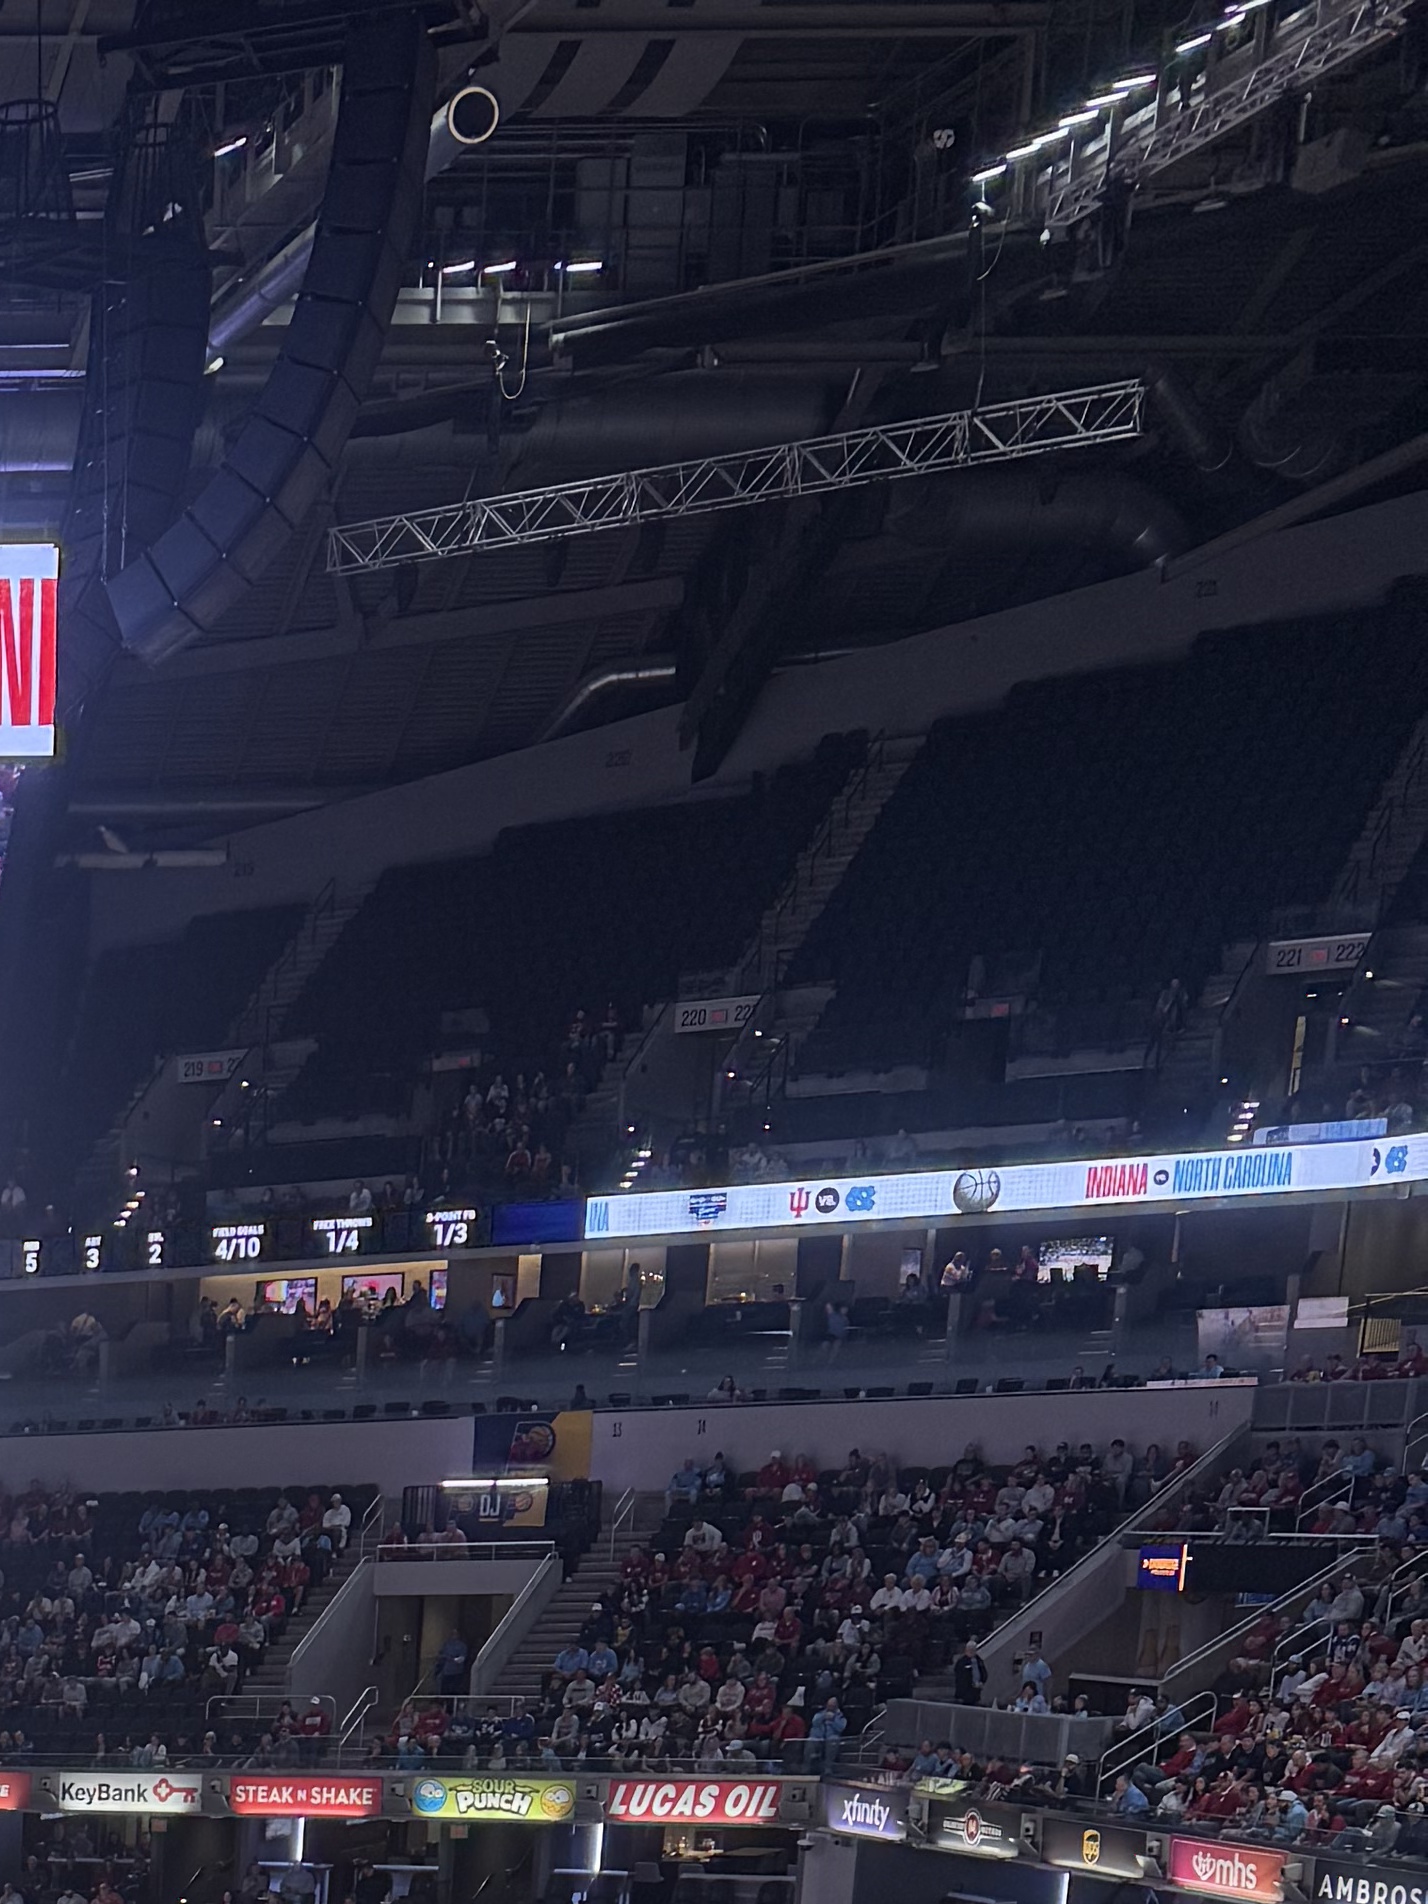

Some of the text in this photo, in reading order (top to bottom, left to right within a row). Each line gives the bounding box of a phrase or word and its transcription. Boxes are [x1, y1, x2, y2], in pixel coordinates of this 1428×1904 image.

[1085, 1152, 1292, 1199] INDIANA NORTH CAROLINA
[326, 1230, 360, 1254] 1/4
[433, 1222, 468, 1247] 1/3
[148, 1243, 162, 1265] 2
[215, 1237, 261, 1260] 4/10
[26, 1252, 38, 1273] 5
[62, 1782, 148, 1805] KeyBank
[236, 1785, 373, 1806] STEAK N SHAKE
[471, 1778, 515, 1794] SOUR
[456, 1790, 535, 1817] PUNCH
[609, 1783, 780, 1818] LUCAS OIL
[842, 1796, 890, 1830] xfinity
[1216, 1849, 1257, 1890] mhs
